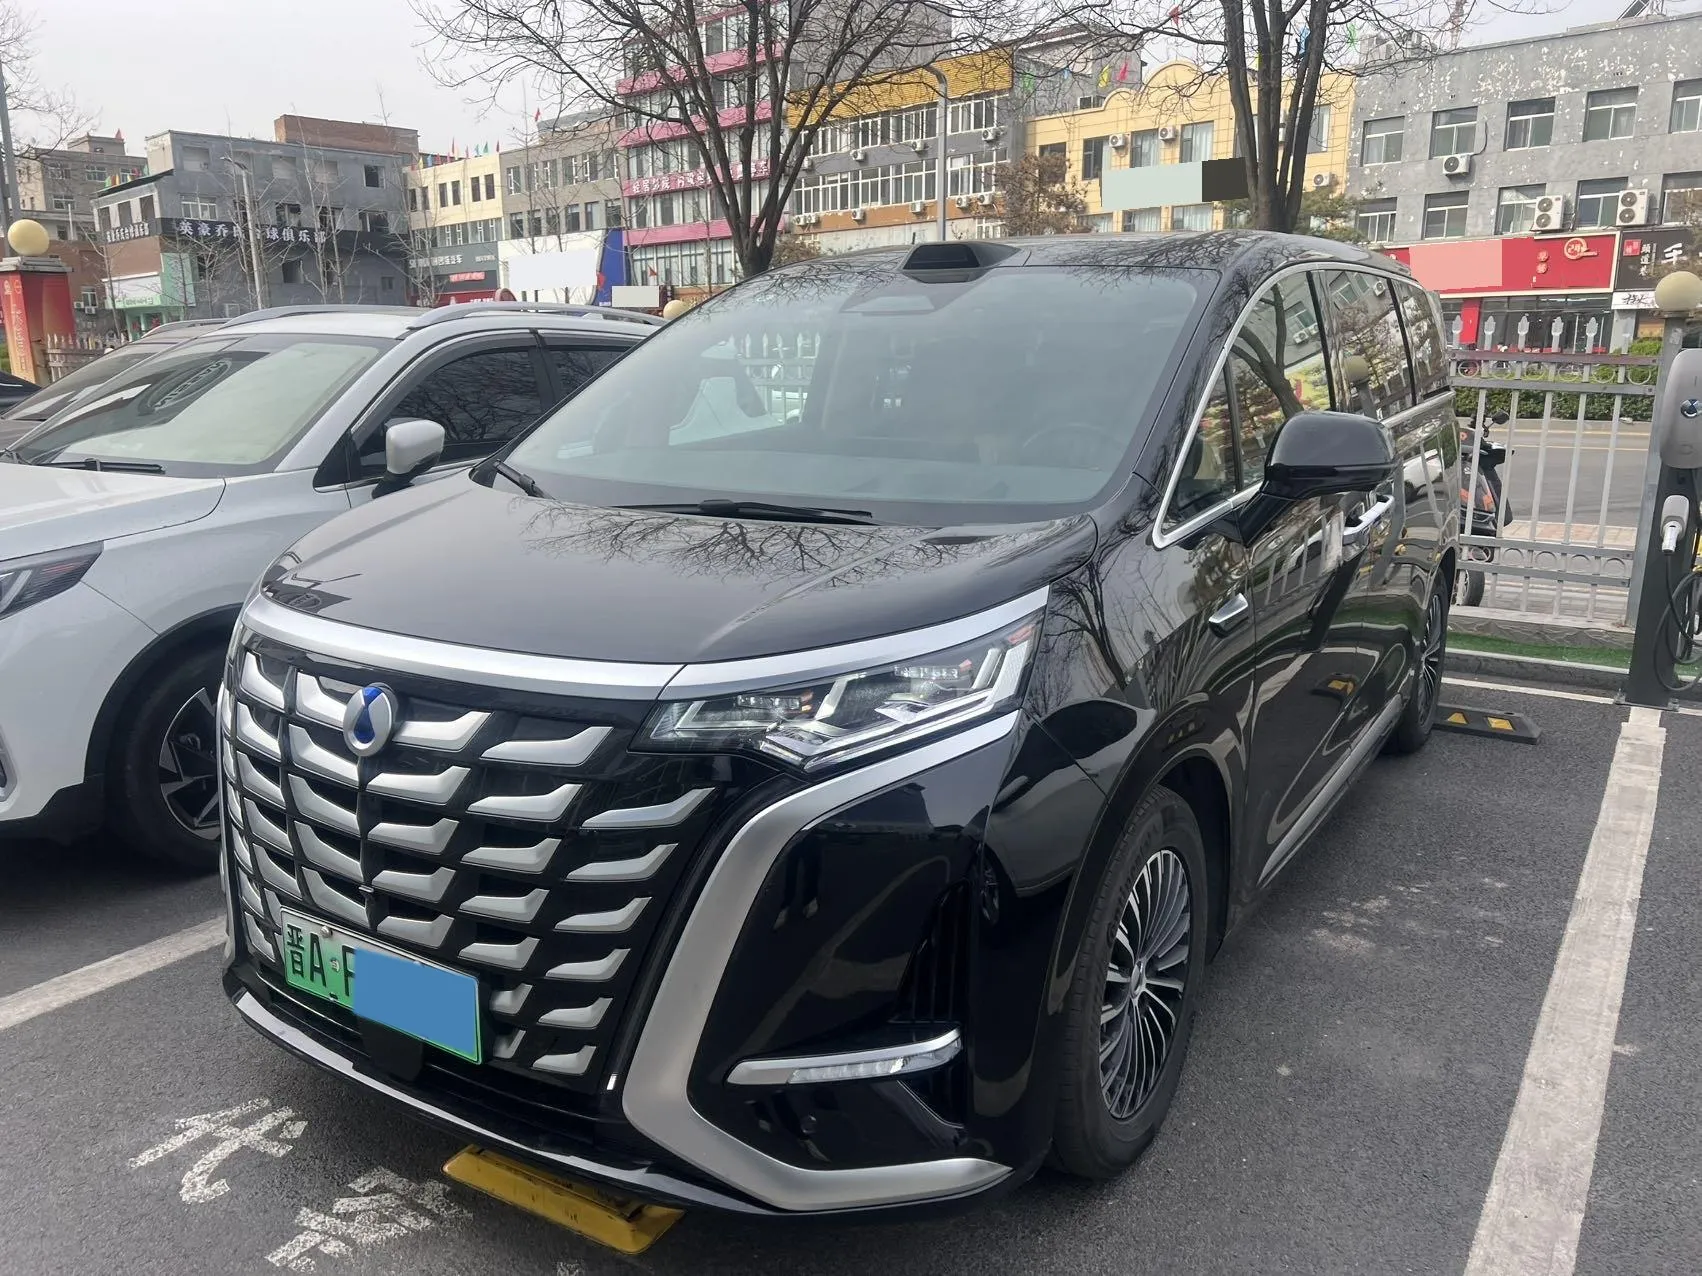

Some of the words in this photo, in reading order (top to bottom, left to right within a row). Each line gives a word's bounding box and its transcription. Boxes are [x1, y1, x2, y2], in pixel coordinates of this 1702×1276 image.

[179, 220, 326, 244] 英豪乔氏球俱乐部
